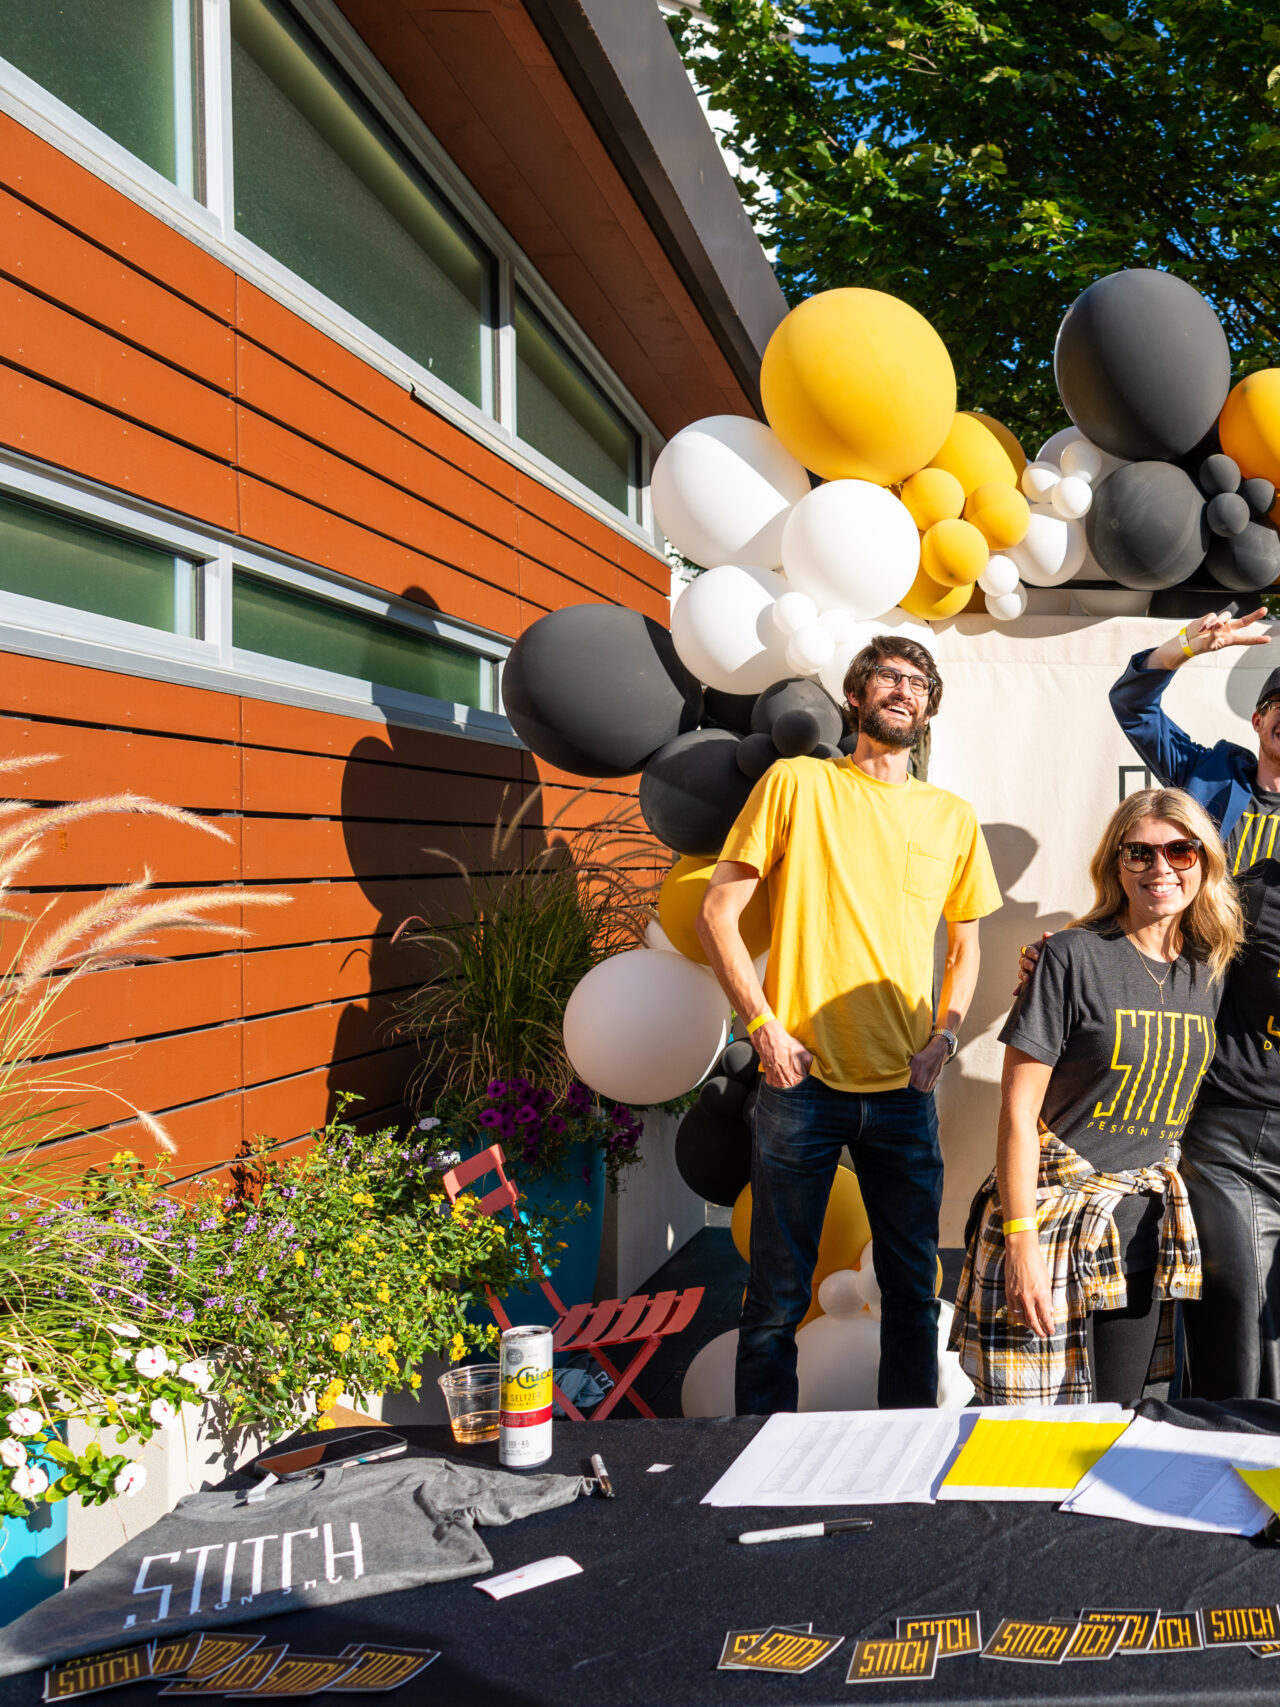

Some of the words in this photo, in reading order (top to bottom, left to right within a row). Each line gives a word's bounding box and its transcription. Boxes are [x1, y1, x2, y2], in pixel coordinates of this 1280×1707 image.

[1093, 1009, 1217, 1126] STITCH
[1086, 1120, 1149, 1137] DESIGN
[123, 1522, 364, 1629] STITCH
[994, 1623, 1069, 1655] STITCH
[1210, 1608, 1275, 1638] STITCH
[746, 1633, 830, 1667] STITCH
[859, 1640, 930, 1673] STITCH
[58, 1653, 140, 1696] STITCH
